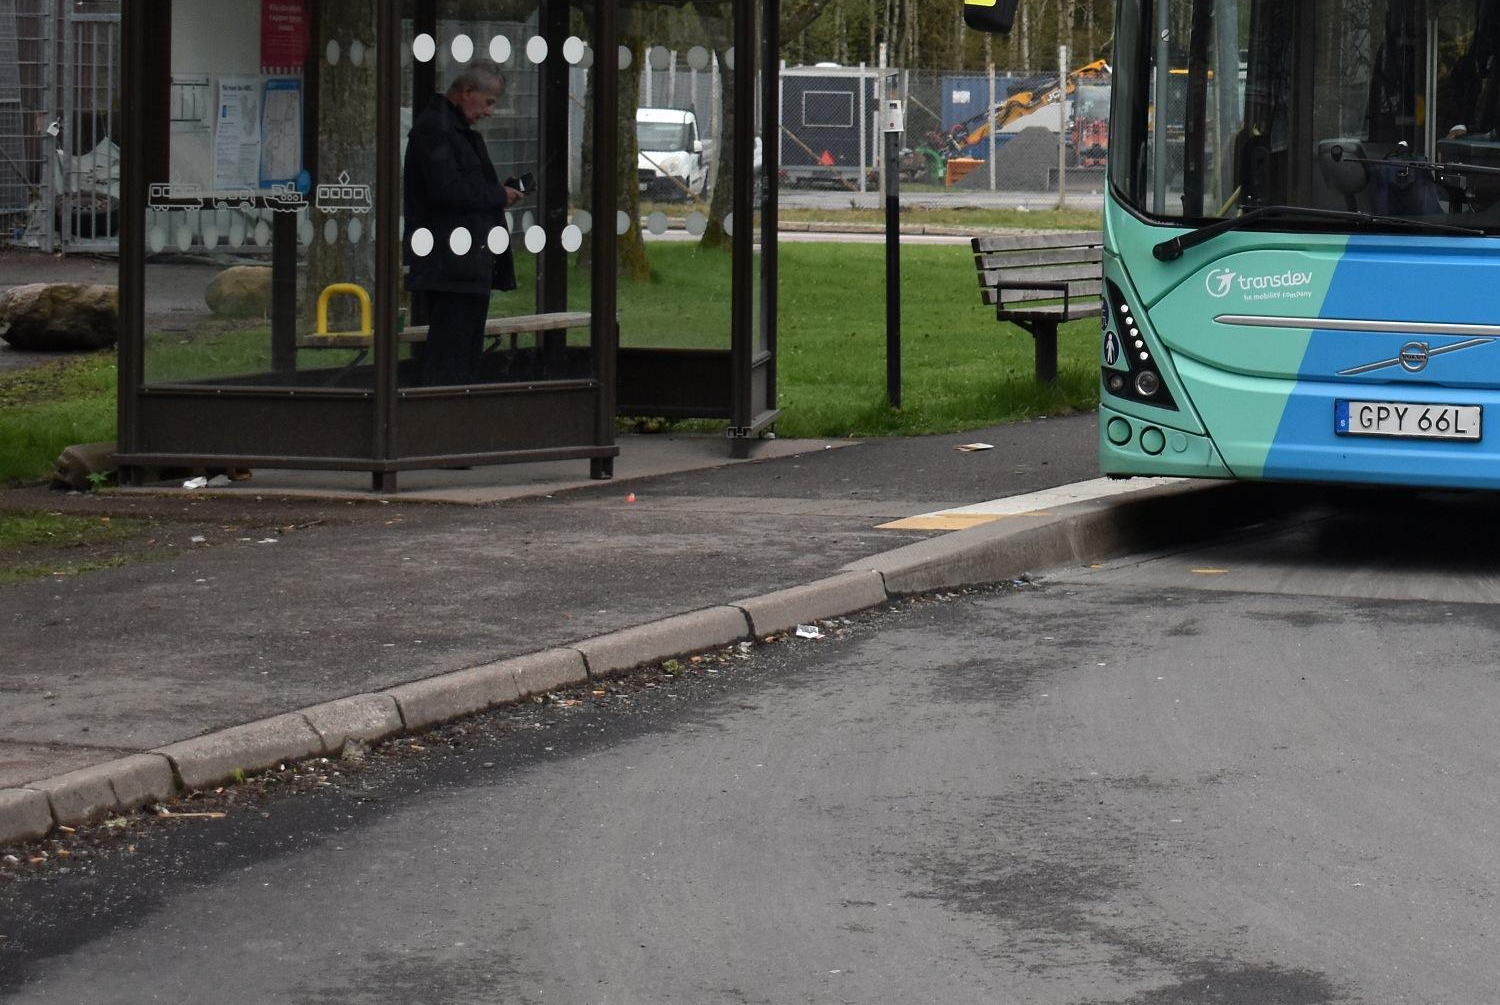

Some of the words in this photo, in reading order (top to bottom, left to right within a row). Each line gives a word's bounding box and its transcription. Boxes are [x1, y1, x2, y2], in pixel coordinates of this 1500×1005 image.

[1237, 270, 1313, 290] transdev
[1253, 291, 1280, 300] mobility
[1282, 291, 1312, 299] company
[1340, 419, 1346, 427] S
[1359, 405, 1409, 431] GPY
[1417, 408, 1468, 434] 66L
